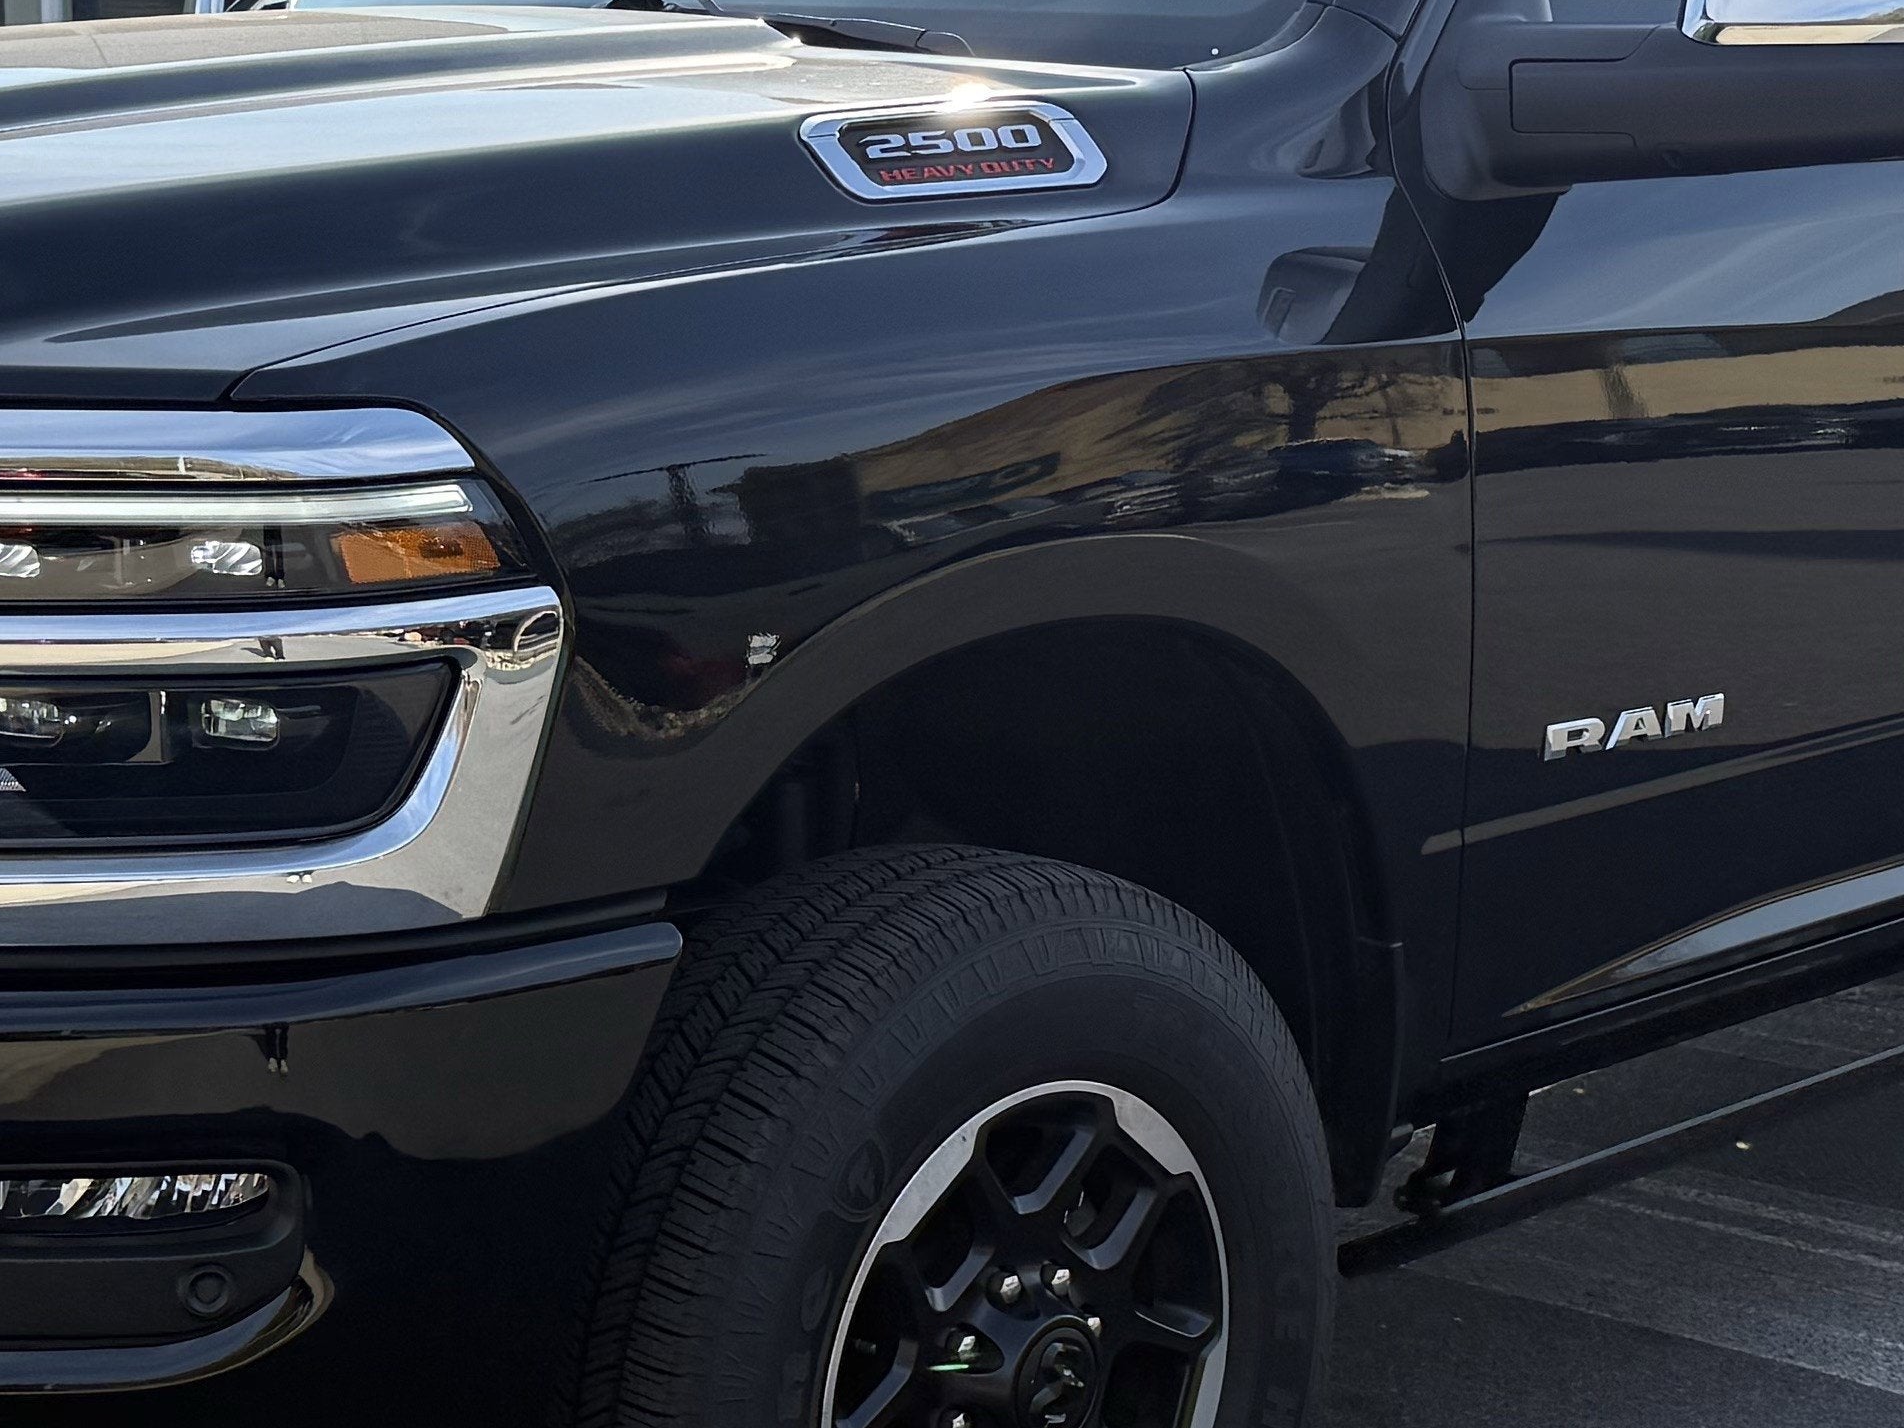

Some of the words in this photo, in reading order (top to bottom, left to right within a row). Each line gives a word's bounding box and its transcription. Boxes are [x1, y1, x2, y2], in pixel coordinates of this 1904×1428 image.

[859, 124, 1042, 159] 2500
[880, 164, 974, 182] HEAVY
[981, 158, 1054, 175] DUTY
[1545, 693, 1724, 761] RAM
